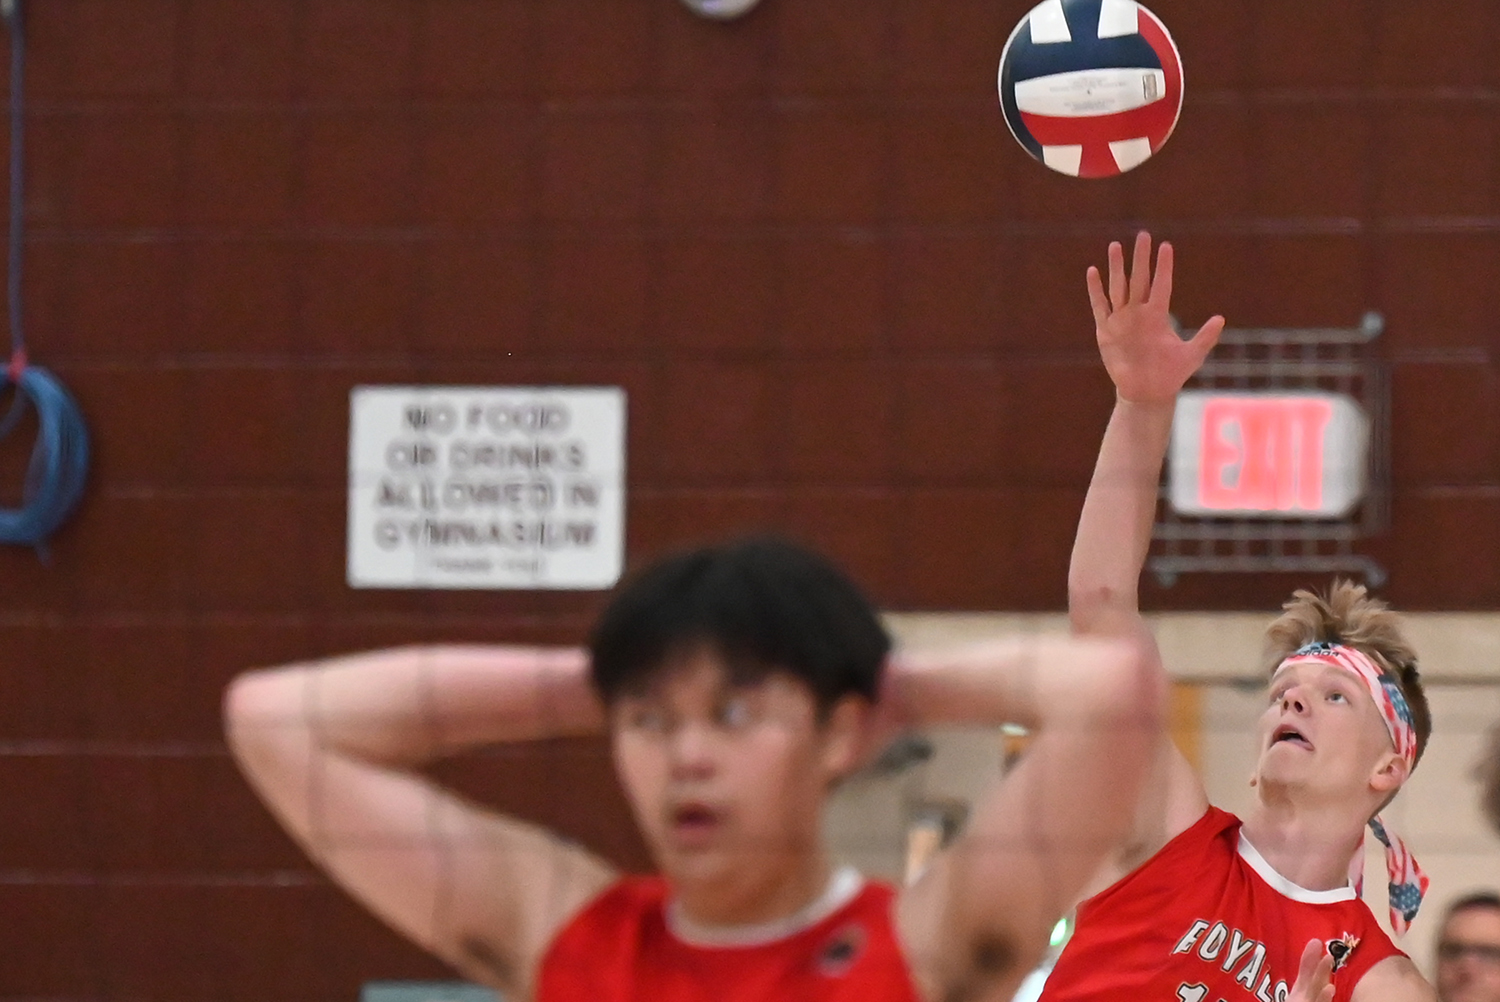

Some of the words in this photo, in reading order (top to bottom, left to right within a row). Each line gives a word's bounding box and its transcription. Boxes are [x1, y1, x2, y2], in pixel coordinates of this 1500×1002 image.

[404, 403, 457, 434] NO
[467, 403, 571, 434] FOOD
[385, 439, 437, 469] OR
[450, 439, 585, 469] DRINKS
[1199, 397, 1332, 511] EXIT
[376, 480, 554, 510] ALLOWED
[563, 481, 599, 510] IN
[374, 519, 597, 550] GYMNASIUM
